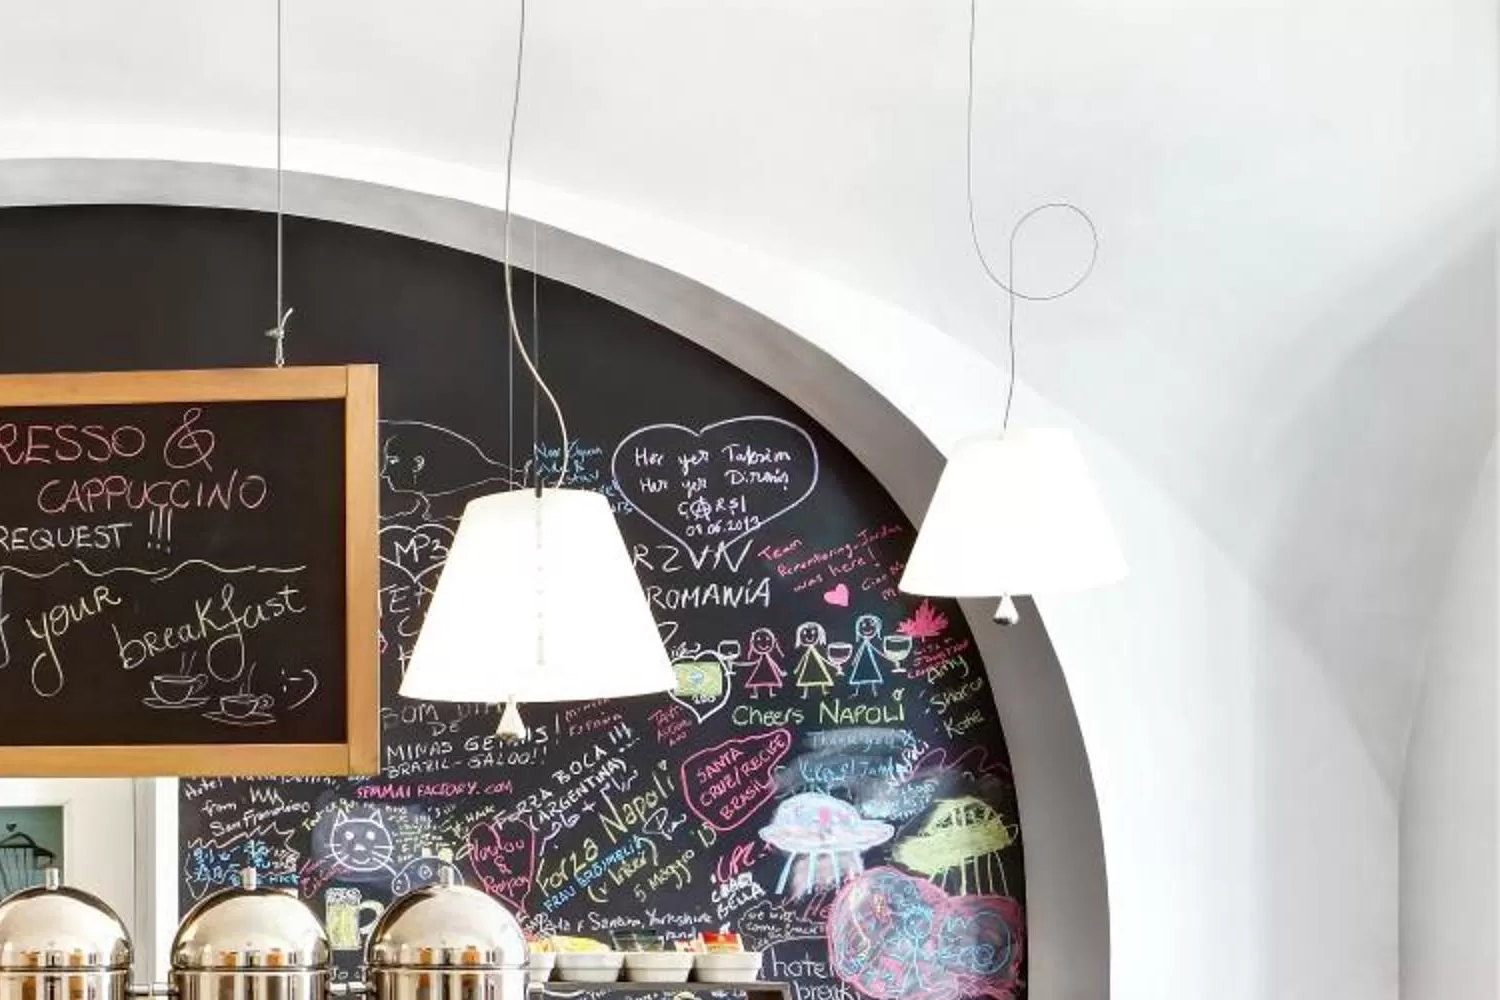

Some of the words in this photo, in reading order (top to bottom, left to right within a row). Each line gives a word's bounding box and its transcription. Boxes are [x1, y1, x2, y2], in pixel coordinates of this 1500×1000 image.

[164, 407, 217, 471] &
[36, 469, 269, 514] CAPPUCCINO
[25, 586, 122, 698] your
[111, 582, 308, 683] breakfast
[818, 698, 905, 725] NAPOLI
